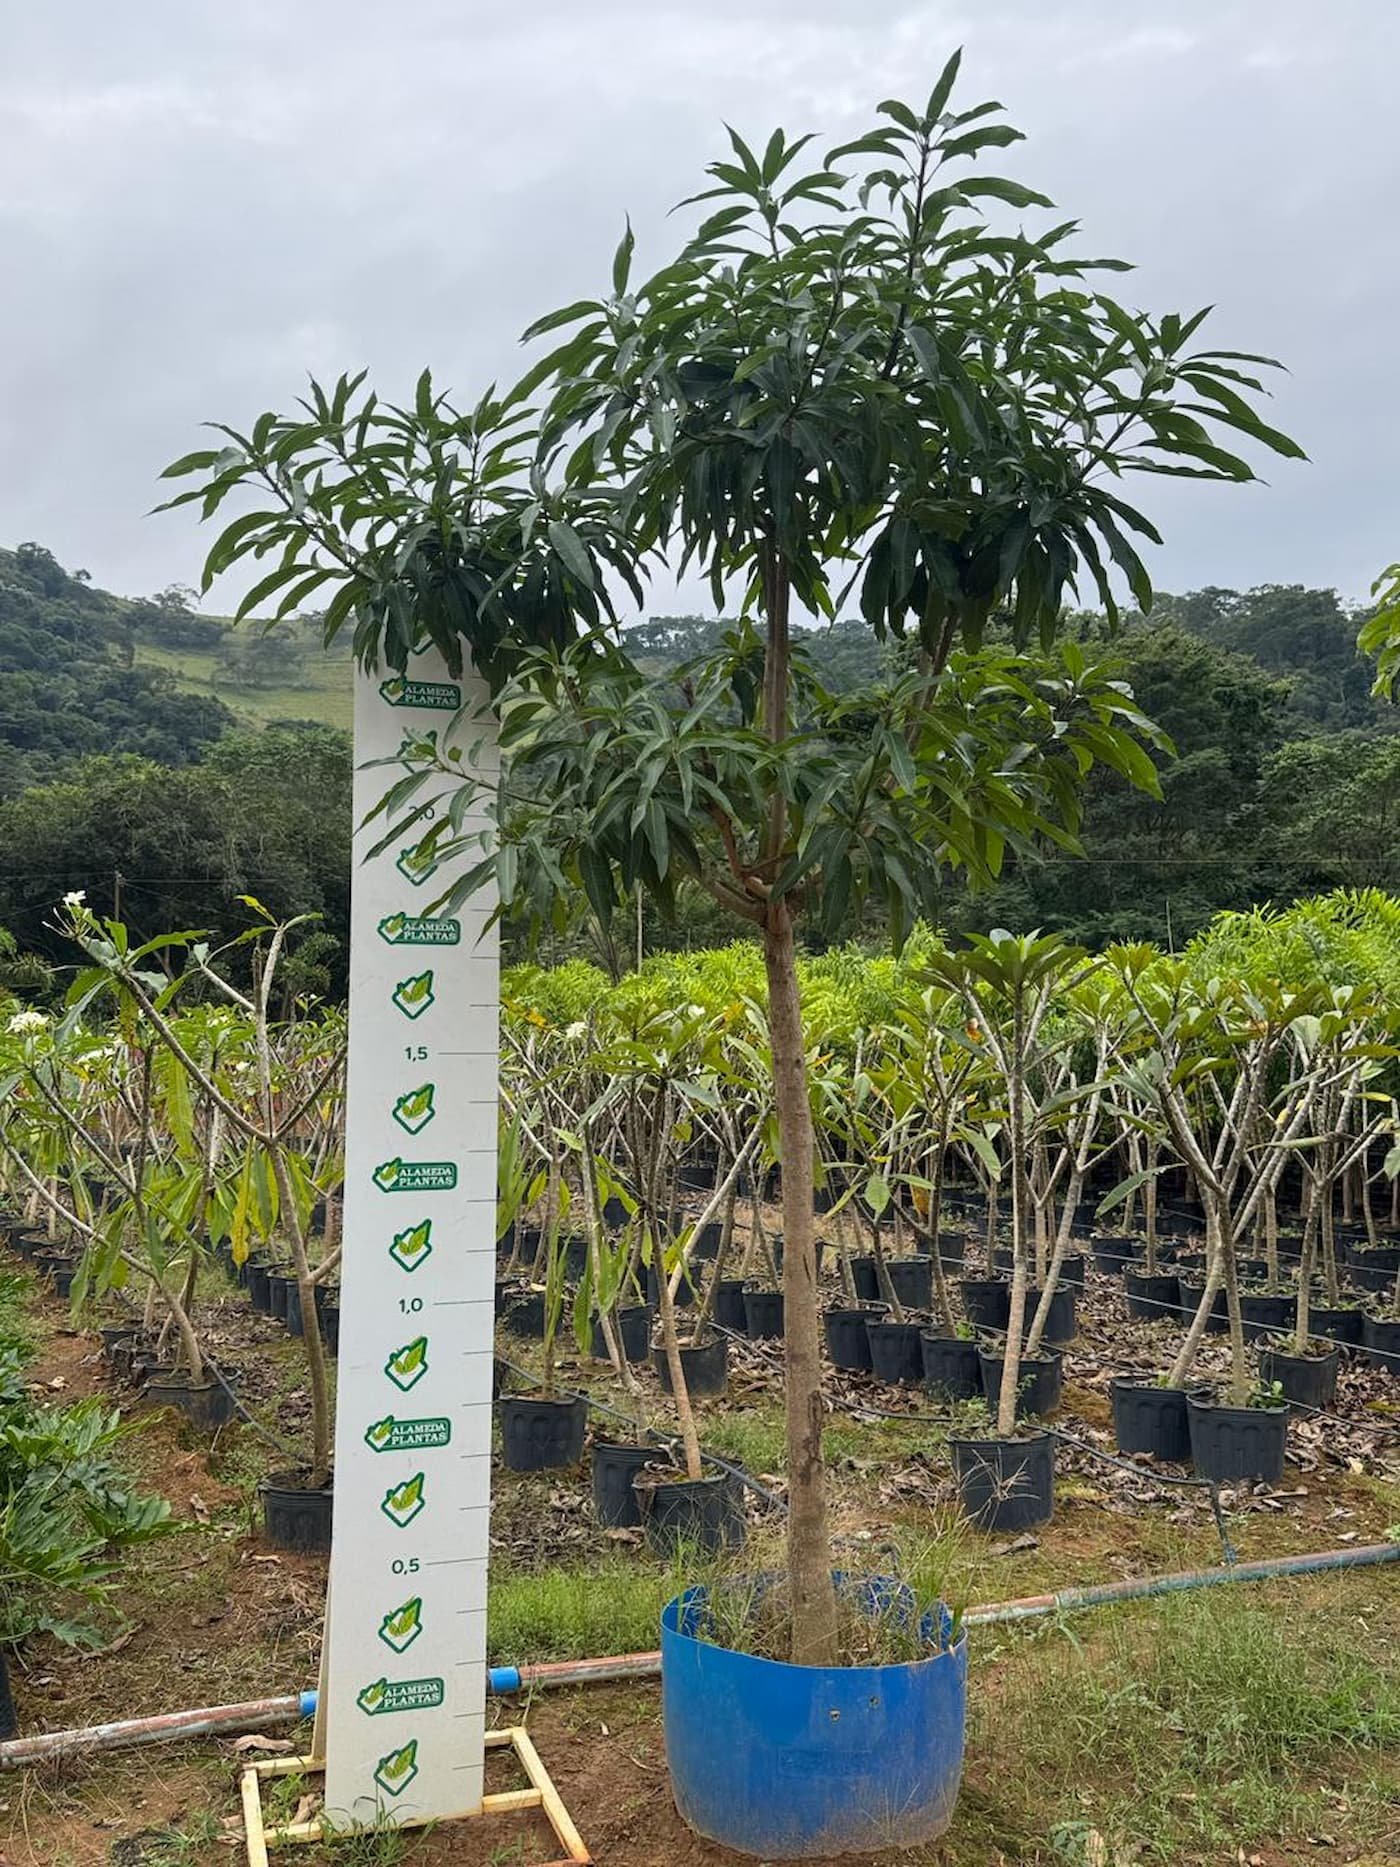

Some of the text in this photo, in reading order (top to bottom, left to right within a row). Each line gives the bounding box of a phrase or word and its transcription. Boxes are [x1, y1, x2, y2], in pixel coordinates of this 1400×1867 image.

[403, 922, 455, 932] ALAMEDA
[403, 931, 457, 941] PLANTAS
[404, 1046, 428, 1062] 1,5
[399, 1167, 453, 1177] ALAMEDA
[399, 1176, 454, 1187] PLANTAS
[398, 1298, 423, 1315] 1,0
[392, 1423, 446, 1436] ALAMEDA
[391, 1432, 447, 1445] PLANTAS
[391, 1557, 420, 1576] 0,5
[384, 1683, 439, 1698] ALAMEDA
[383, 1693, 439, 1709] PLANTAS
